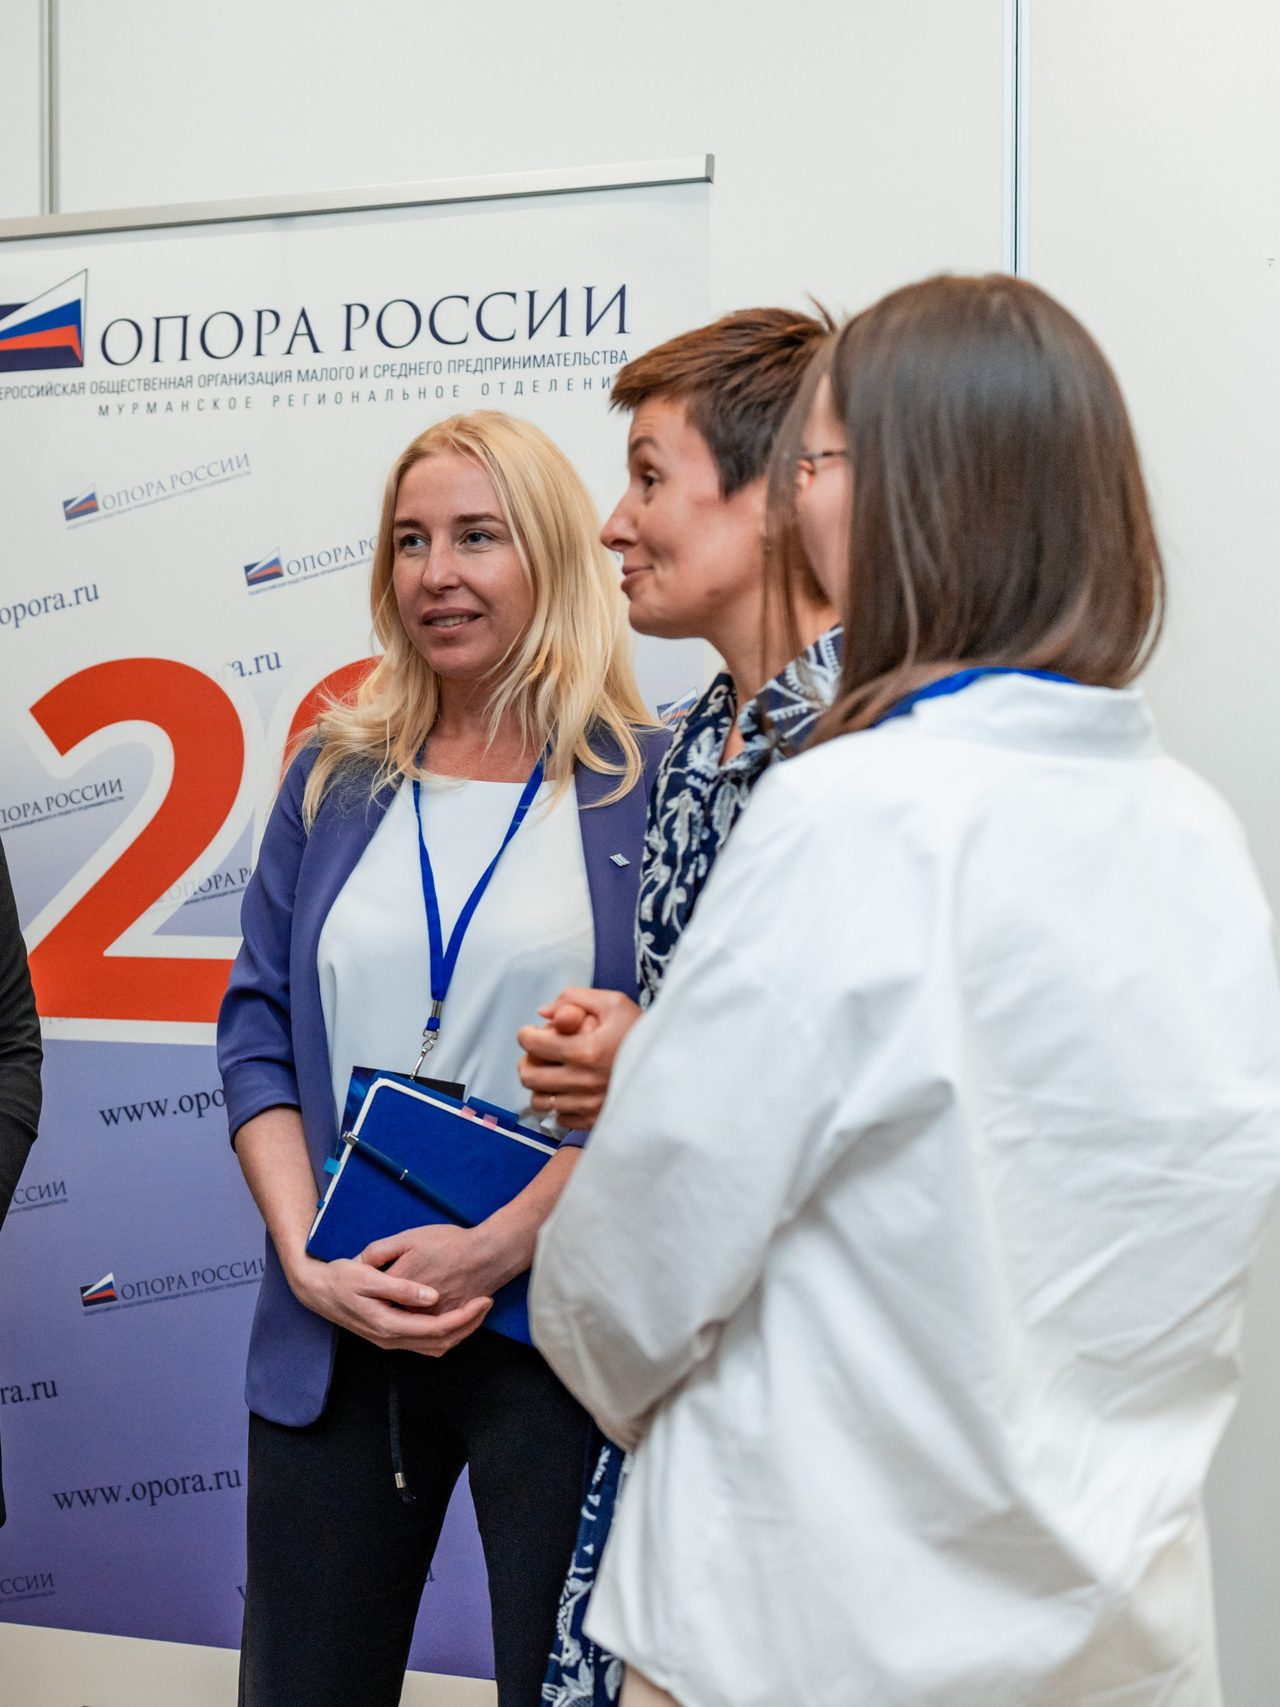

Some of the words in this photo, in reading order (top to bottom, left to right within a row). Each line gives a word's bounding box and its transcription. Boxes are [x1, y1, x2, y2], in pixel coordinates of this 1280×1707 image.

[100, 307, 322, 367] ОПОРА
[342, 282, 633, 353] РОССИИ
[89, 375, 194, 395] ОБЩЕСТВЕННАЯ
[197, 369, 293, 389] ОРГАНИЗАЦИЯ
[297, 364, 355, 384] МАЛОГО
[359, 364, 369, 379] И
[373, 359, 443, 379] СРЕДНЕГО
[447, 349, 629, 375] ПРЕДПРИНИМАТЕЛЬСТВА
[98, 396, 252, 417] МУРМАНСКОЕ
[272, 384, 461, 408] РЕГИОНАЛЬНОЕ
[481, 376, 612, 397] ОТДЕЛЕНИ
[101, 479, 167, 511] ОПОРА
[169, 452, 251, 491] РОССИИ
[286, 544, 356, 577] ОПОРА
[45, 778, 123, 812] РОССИИ
[98, 1088, 226, 1127] www.opo
[13, 1180, 67, 1205] ССИИ
[120, 1273, 189, 1301] ОПОРА
[53, 1468, 243, 1511] www.opora.ru
